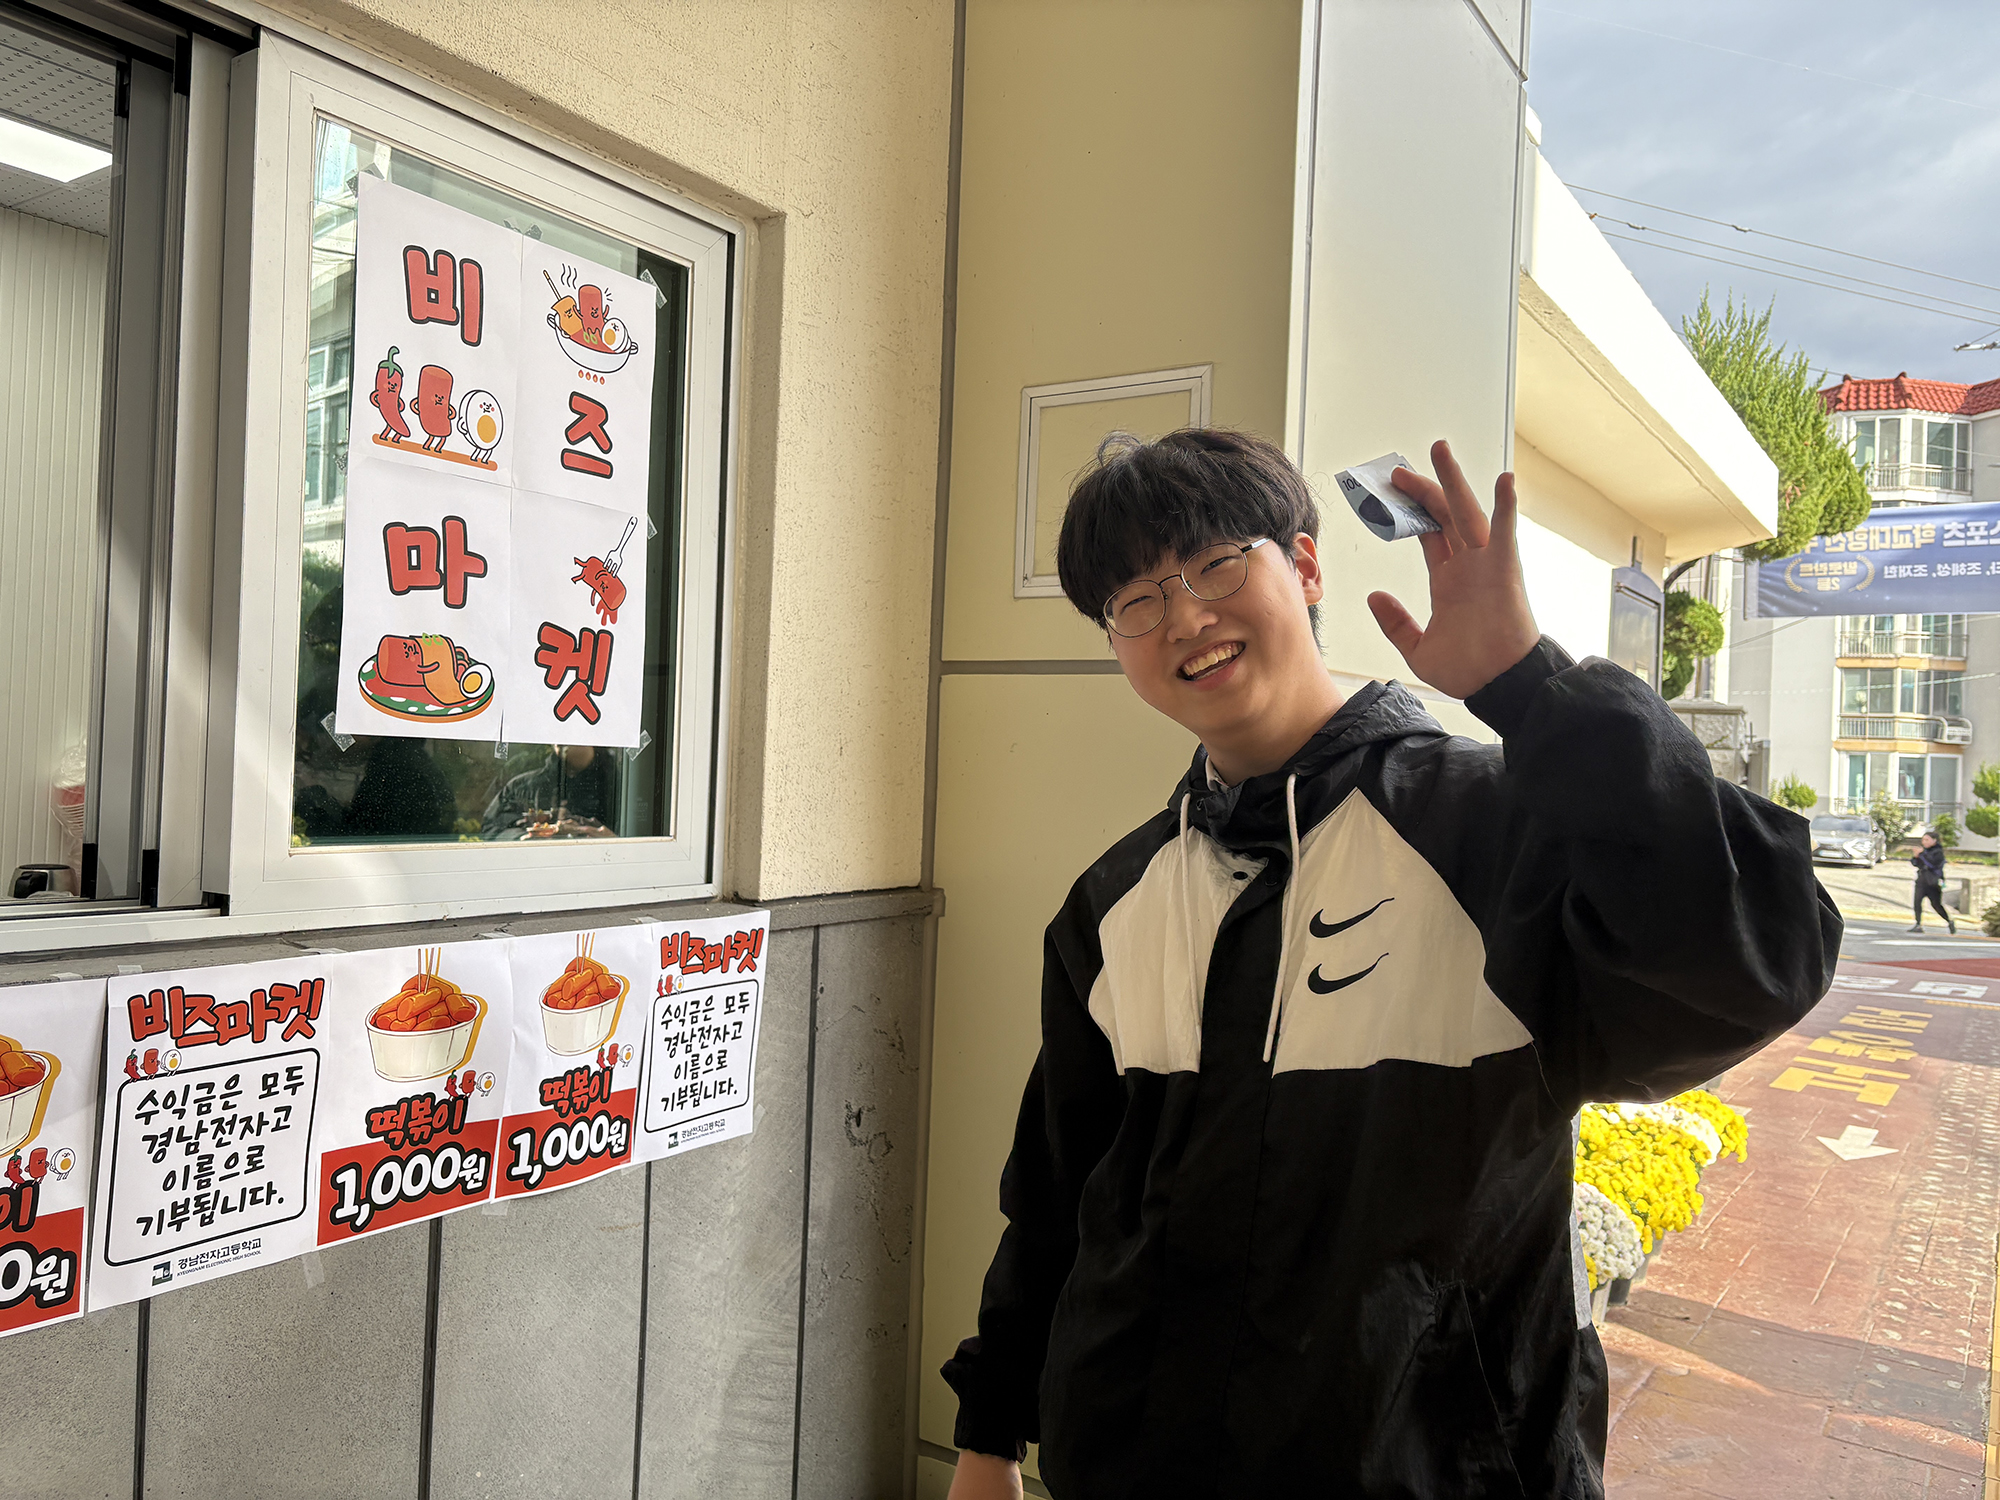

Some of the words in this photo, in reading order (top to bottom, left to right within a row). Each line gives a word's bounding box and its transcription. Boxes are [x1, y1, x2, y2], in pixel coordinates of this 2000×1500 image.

[403, 244, 483, 347] 비
[560, 390, 614, 479] 즈
[382, 514, 488, 609] 마
[534, 620, 614, 725] 켓
[660, 927, 765, 976] 비즈마켓
[127, 978, 325, 1048] 비즈마켓
[661, 994, 715, 1030] 수익금은
[724, 991, 751, 1016] 모두
[664, 1020, 744, 1059] 경남전자고
[674, 1049, 728, 1081] 이름으로
[135, 1074, 243, 1126] 수익금은
[258, 1065, 305, 1100] 모두
[541, 1066, 612, 1117] 떡볶이
[661, 1077, 738, 1113] 기부됩니다.
[141, 1105, 292, 1164] 경남전자고
[367, 1093, 468, 1149] 떡볶이
[162, 1144, 265, 1192] 이름으로
[508, 1112, 629, 1187] 1,000원
[136, 1181, 284, 1236] 기부됩니다.
[332, 1144, 489, 1230] 1,000원
[178, 1237, 262, 1270] 경남전자고등학교
